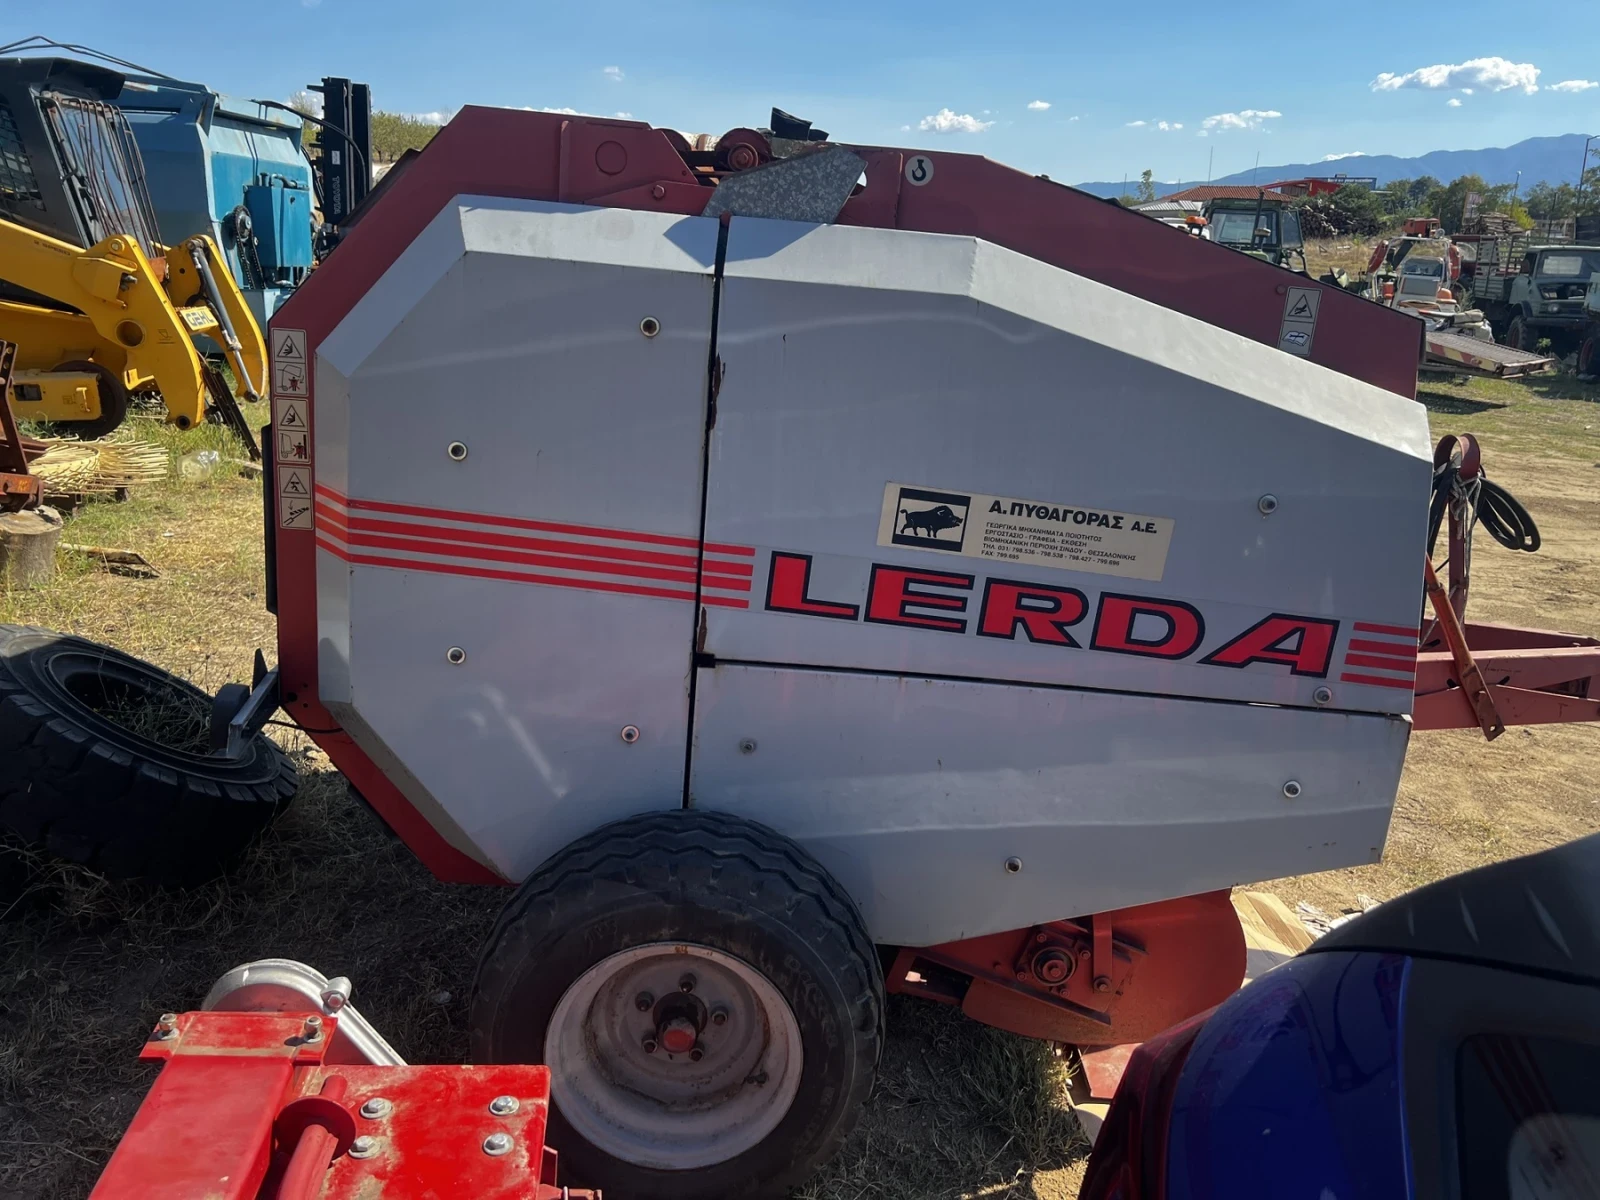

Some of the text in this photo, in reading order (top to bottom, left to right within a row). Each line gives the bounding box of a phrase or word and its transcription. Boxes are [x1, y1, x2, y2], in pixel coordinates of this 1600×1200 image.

[185, 311, 215, 327] GEHL
[985, 529, 1024, 539] ΕΡΓΟΣΤΑΣΙΟ
[1028, 534, 1056, 543] ΓΡΑΦΕΙΑ
[1061, 539, 1087, 547] ΕΚΘΕΣΗ
[986, 522, 1102, 542] ΓΕΩΡΓΙΚΑ ΜΗΧΑΝΗΜΑΤΑ ΠΟΙΟΤΗΤΟΣ
[983, 536, 1029, 547] ΒΙΟΜΗΧΑΝΙΚΗ
[1029, 542, 1058, 551] ΠΕΡΙΟΧΗ
[1059, 546, 1084, 554] ΣΙΝΔΟΥ
[1088, 549, 1136, 561] ΘΕΣΣΑΛΟΝΙΚΗΣ
[765, 550, 1342, 679] LERDA
